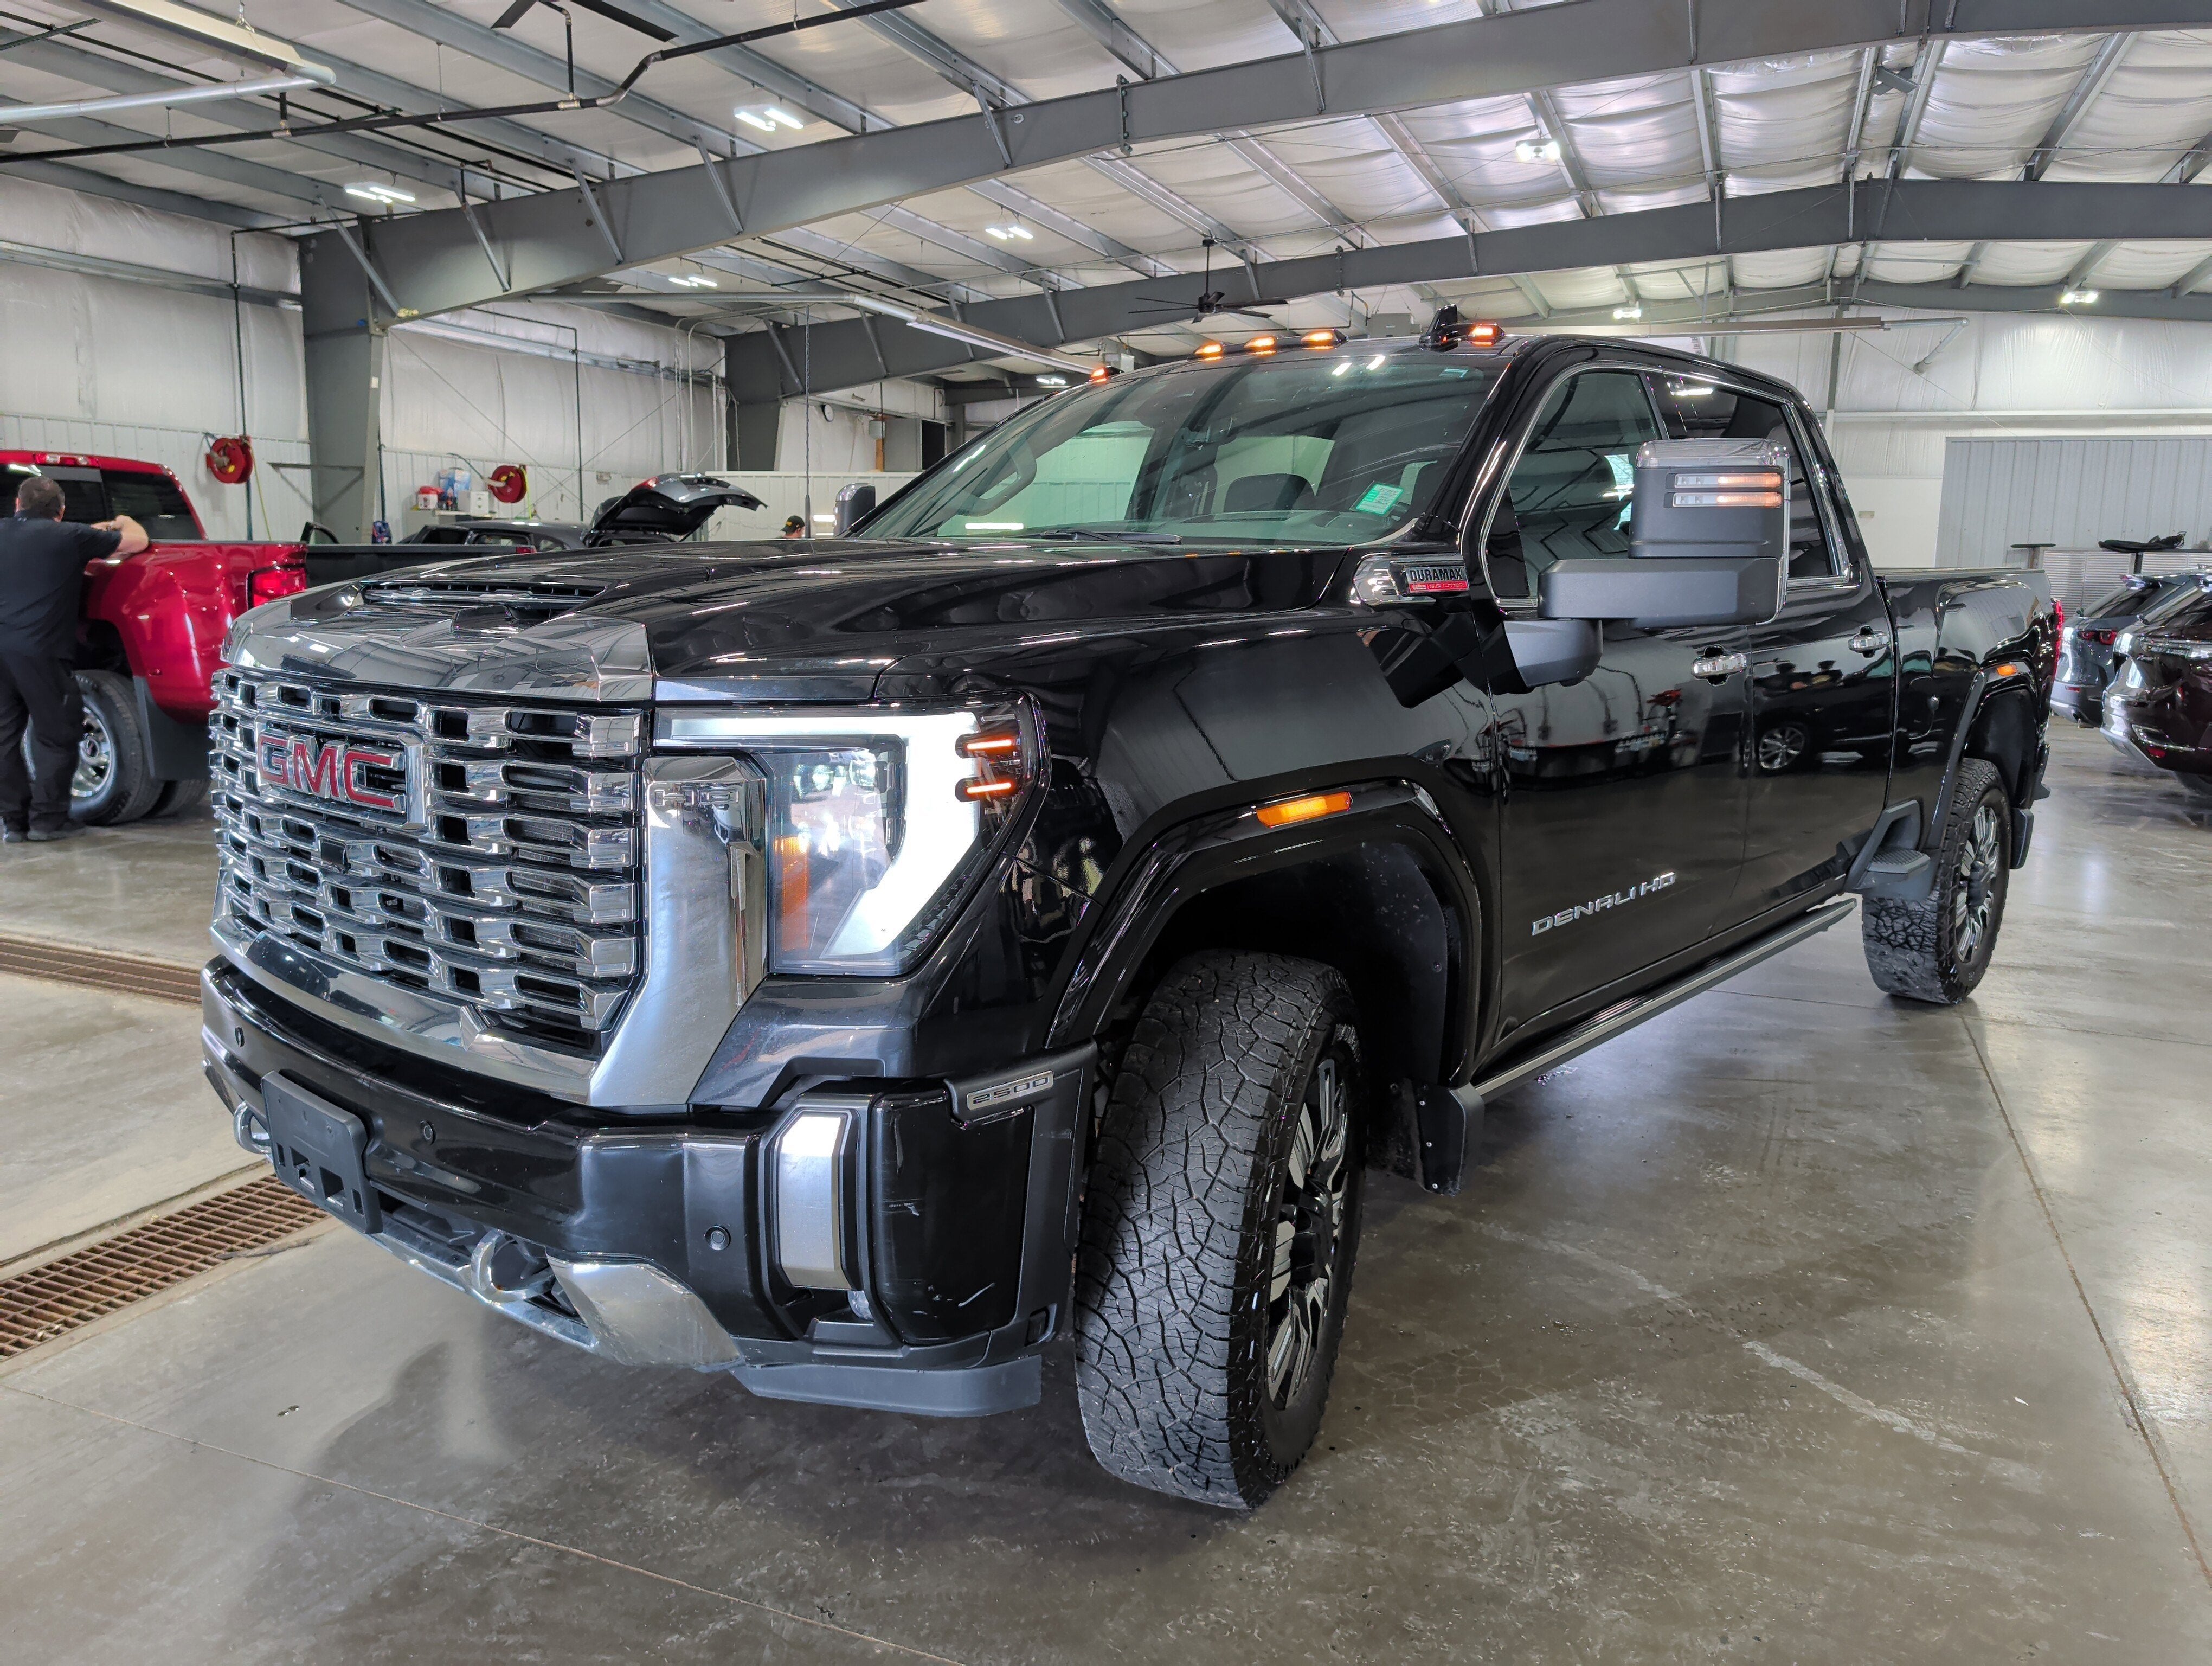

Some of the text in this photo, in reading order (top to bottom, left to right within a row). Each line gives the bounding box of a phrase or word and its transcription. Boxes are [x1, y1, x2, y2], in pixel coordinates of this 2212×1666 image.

[1410, 568, 1463, 581] DURAMAX
[258, 732, 405, 813] GMC
[1532, 872, 1676, 936] DENALI HD
[973, 1077, 1049, 1104] 2500
